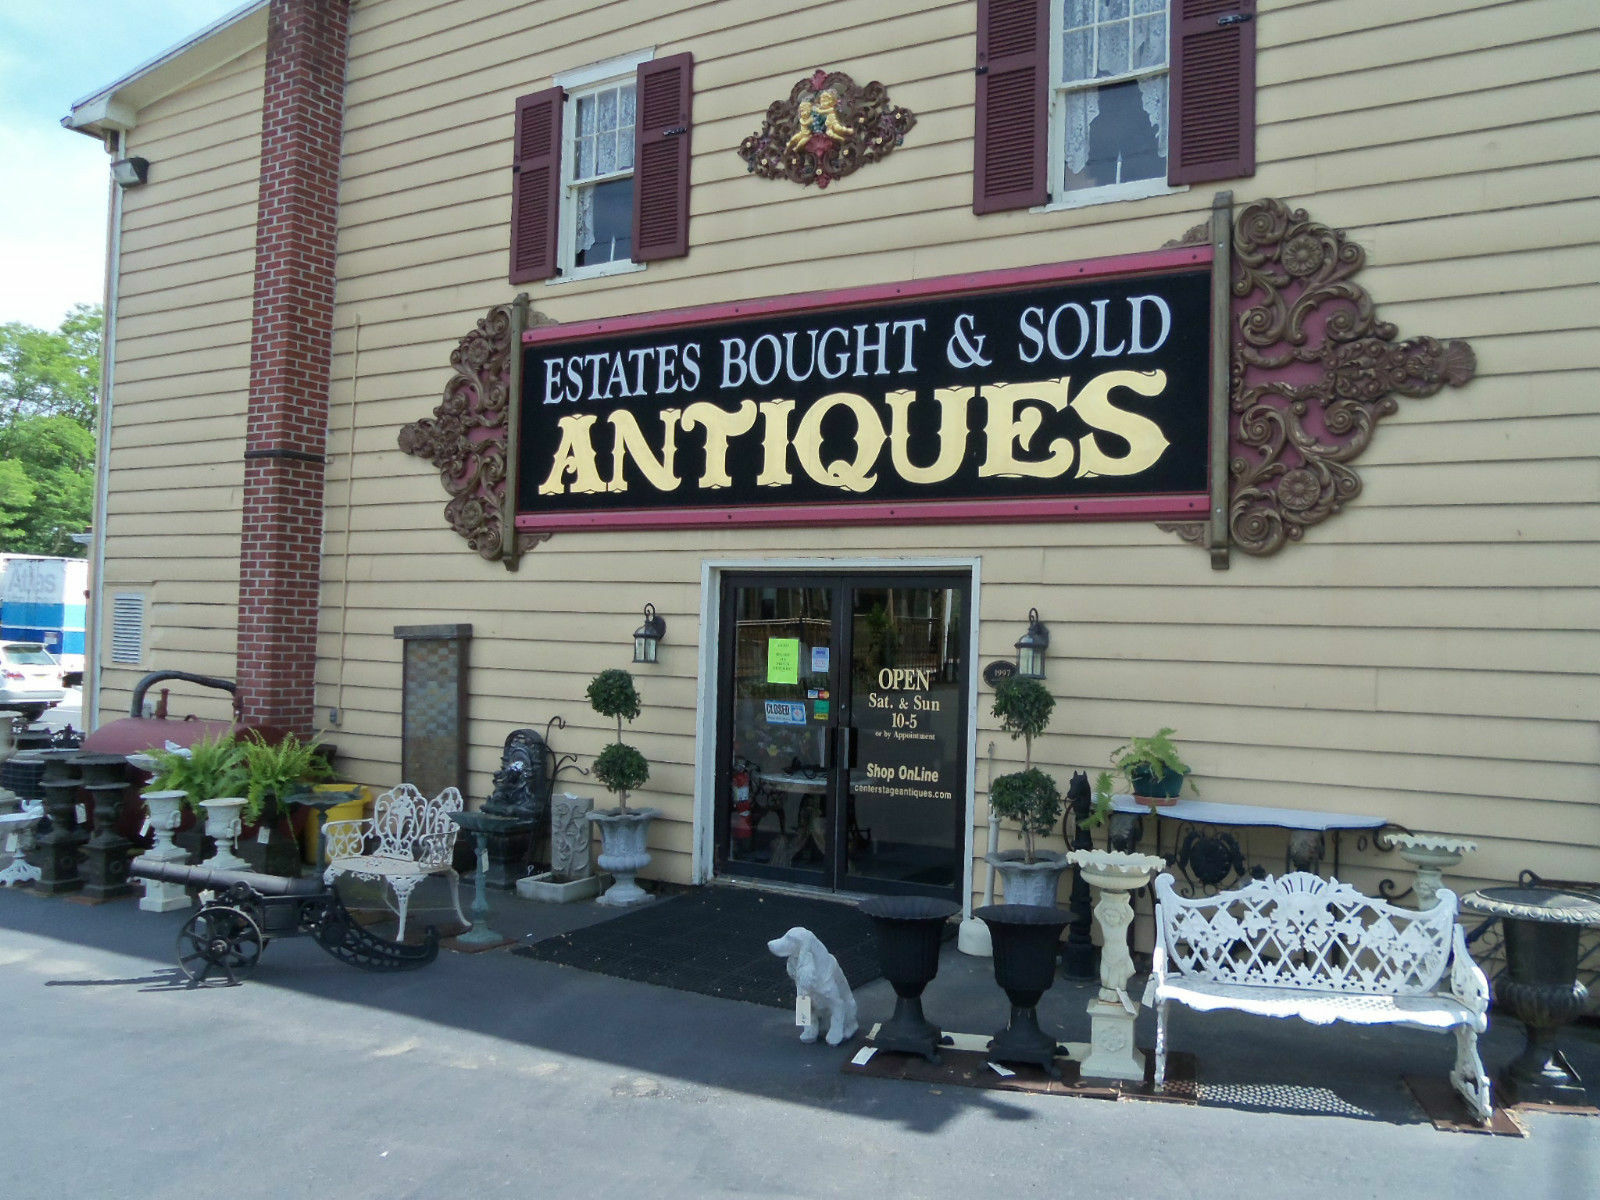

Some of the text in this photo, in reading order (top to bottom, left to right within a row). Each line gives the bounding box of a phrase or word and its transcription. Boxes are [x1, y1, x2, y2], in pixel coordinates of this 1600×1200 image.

[542, 294, 1172, 405] ESTATES BOUGHT & SOLD
[538, 369, 1171, 496] ANTIQUES
[878, 667, 931, 691] OPEN
[766, 703, 790, 715] CLOSED
[868, 692, 940, 711] Sat. & Sun
[891, 712, 918, 729] 10-5
[883, 730, 892, 739] by
[893, 730, 936, 741] Appointment
[866, 762, 939, 783] Shop OnLine
[854, 784, 952, 799] centerstageantiques.com
